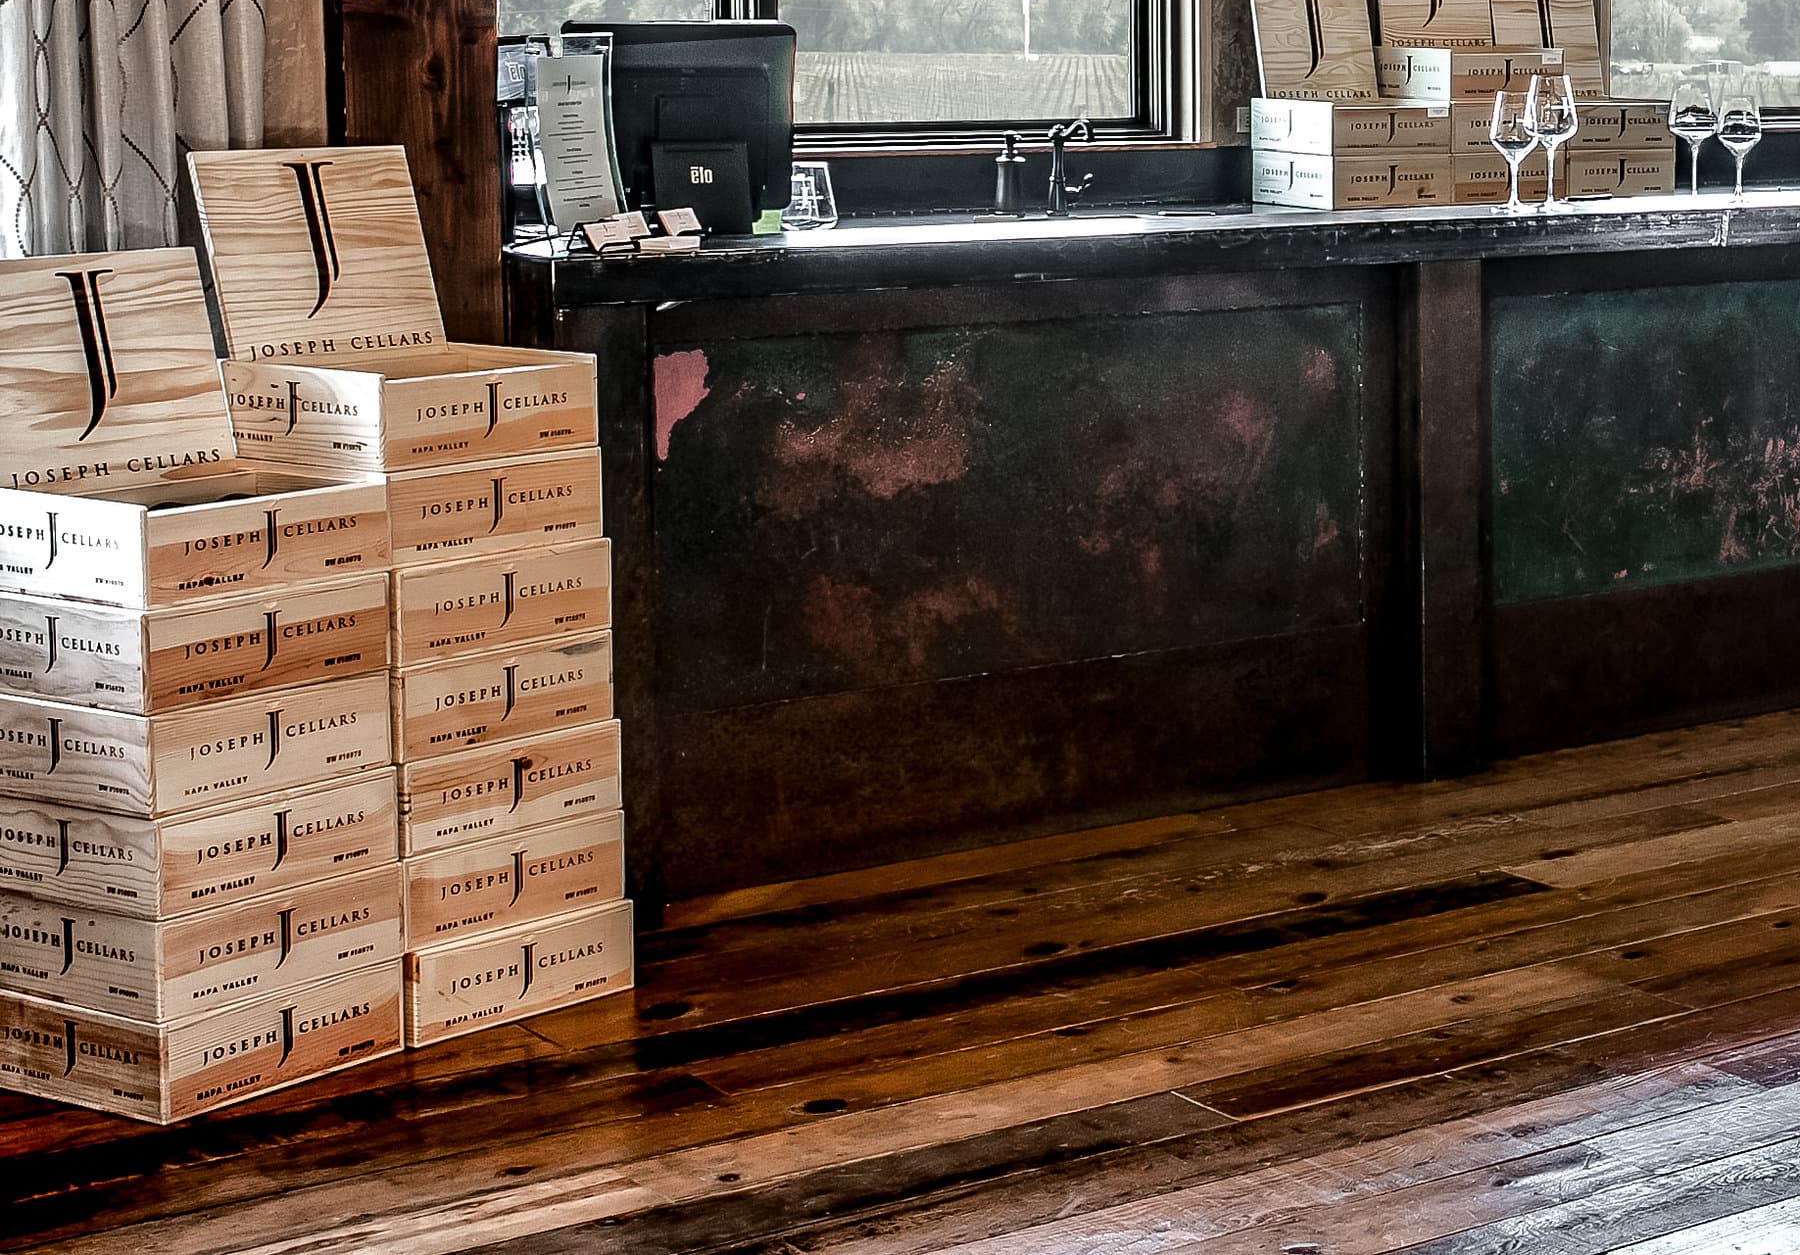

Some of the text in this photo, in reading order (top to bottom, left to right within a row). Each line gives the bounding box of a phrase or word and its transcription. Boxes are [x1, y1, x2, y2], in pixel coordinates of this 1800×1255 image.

[1380, 64, 1406, 72] JOSEPH
[1406, 56, 1413, 85] J
[1391, 39, 1486, 47] JOSEPH CELLARS
[1503, 59, 1512, 89] J
[1387, 113, 1398, 143] J
[1585, 109, 1660, 138] JOSEPH J CELLARS
[1262, 168, 1288, 176] JOSEPH
[1288, 162, 1294, 190] J
[1387, 165, 1398, 195] J
[1398, 173, 1434, 181] CELLARS
[1470, 171, 1505, 179] JOSEPH
[1517, 169, 1548, 177] CELLAR
[1585, 168, 1617, 176] JOSEPH
[1617, 159, 1627, 188] J
[282, 161, 340, 319] J
[54, 269, 118, 441] J
[249, 331, 433, 361] JOSEPH CELLARS
[230, 381, 358, 436] JOSEPH J CELLARS
[417, 382, 568, 439] JOSEPH J CELLARS
[12, 449, 221, 489] JOSEPH CELLARS
[438, 442, 469, 450] VALLEY
[422, 477, 573, 533] JOSEPH J CELLARS
[0, 512, 119, 569] OSEPH J CELLARS
[184, 509, 358, 569] JOSEPH J CELLARS
[435, 571, 582, 628] JOSEPH J CELLARS
[45, 616, 60, 673] J
[61, 637, 120, 655] CELLARS
[184, 610, 356, 672] JOSEPH J CELLARS
[435, 665, 584, 721] JOSEPH J CELLARS
[0, 718, 125, 775] OSEPH J CELLARS
[190, 709, 357, 770] JOSEPH J CELLARS
[184, 776, 248, 796] NAPA VALLEY
[442, 757, 592, 813] JOSEPH J CELLARS
[56, 819, 72, 876] J
[72, 841, 133, 861] CELLARS
[197, 809, 365, 871] JOSEPH J CELLARS
[463, 819, 494, 830] VALLEY
[441, 850, 594, 907] JOSEPH J CELLARS
[5, 917, 135, 975] JOSEPH J CELLARS
[200, 908, 370, 969] JOSEPH J CELLARS
[451, 942, 603, 999] JOSEPH J CELLARS
[5, 1020, 139, 1077] JOSEPH J CELLARS
[203, 1002, 370, 1068] JOSEPH J CELLARS
